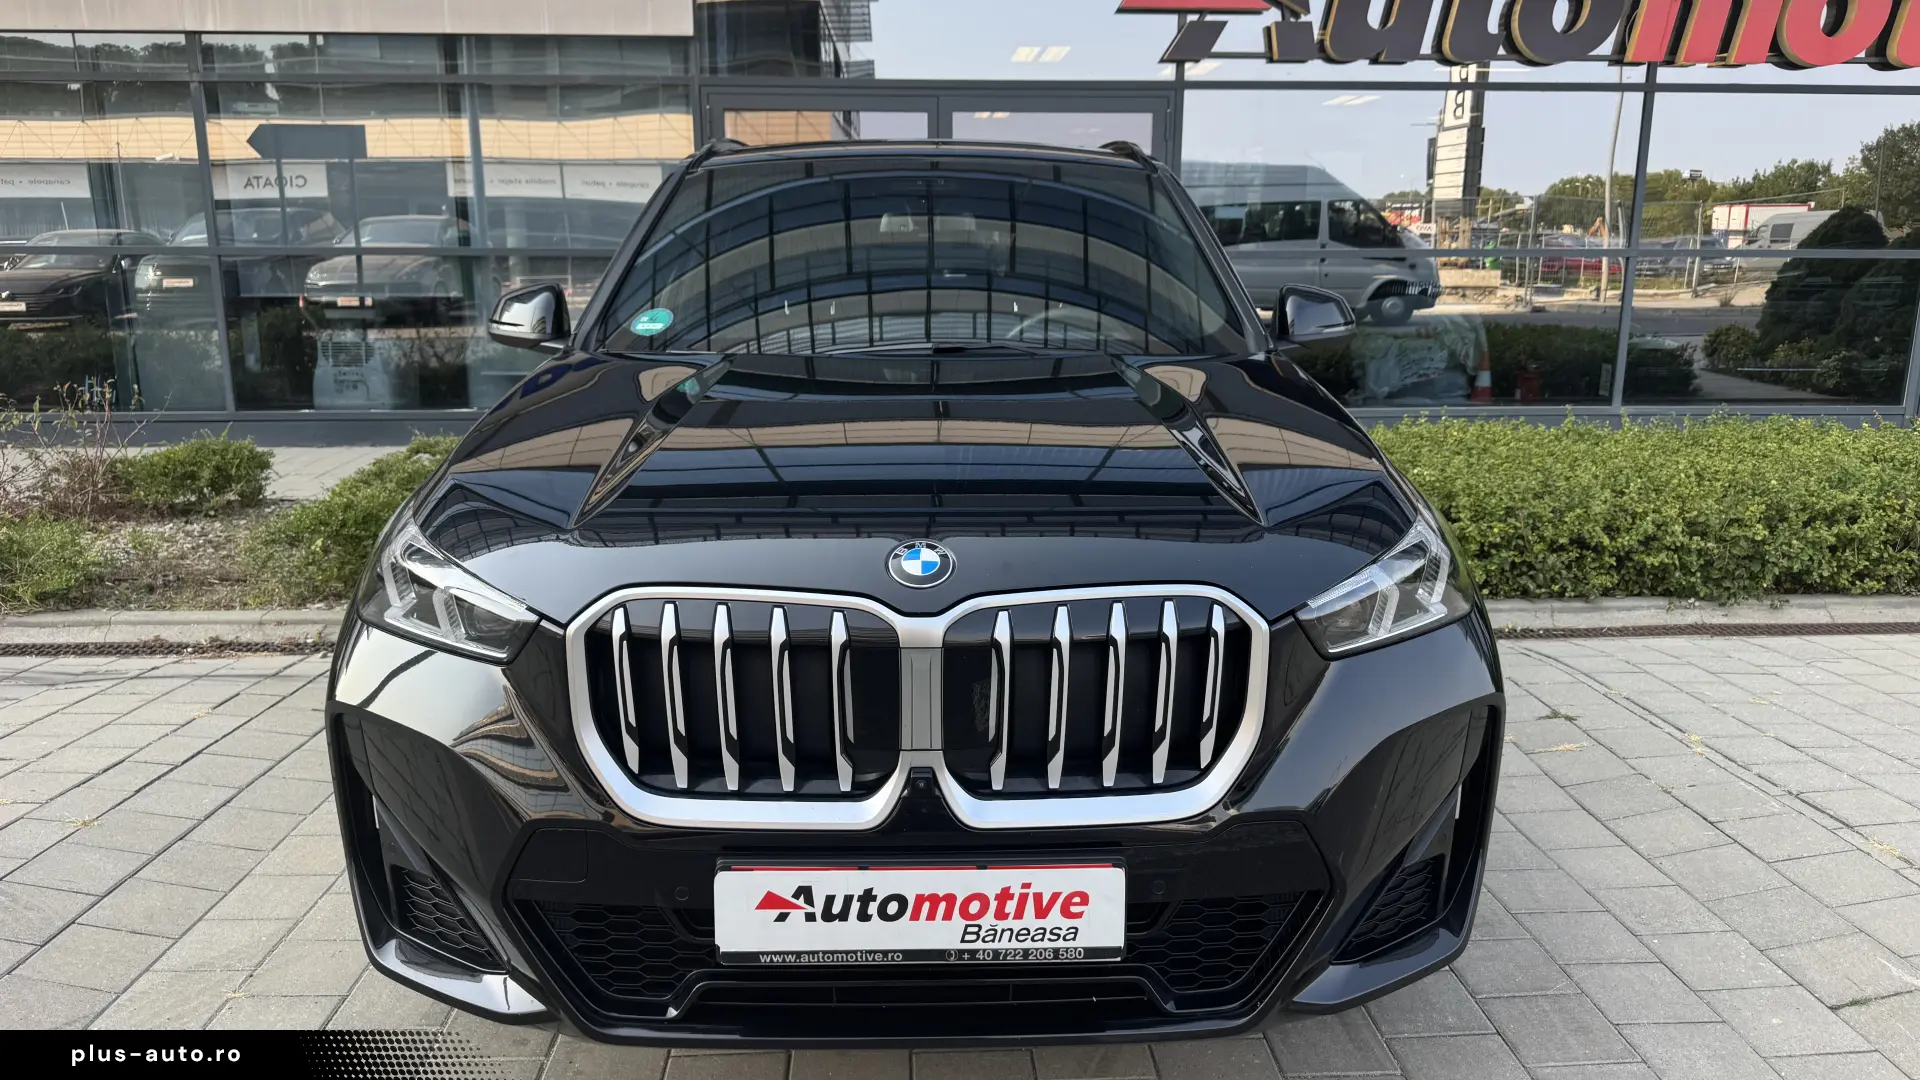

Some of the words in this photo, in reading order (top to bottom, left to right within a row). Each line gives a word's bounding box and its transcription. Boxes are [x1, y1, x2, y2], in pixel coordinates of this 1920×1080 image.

[896, 542, 946, 555] BMW
[755, 882, 1090, 922] Automotive
[959, 923, 1079, 944] Băneasa
[759, 951, 904, 963] www.automotive.ro
[974, 949, 993, 961] 40
[998, 948, 1024, 961] 722
[1028, 948, 1055, 961] 206
[1058, 948, 1085, 960] 580
